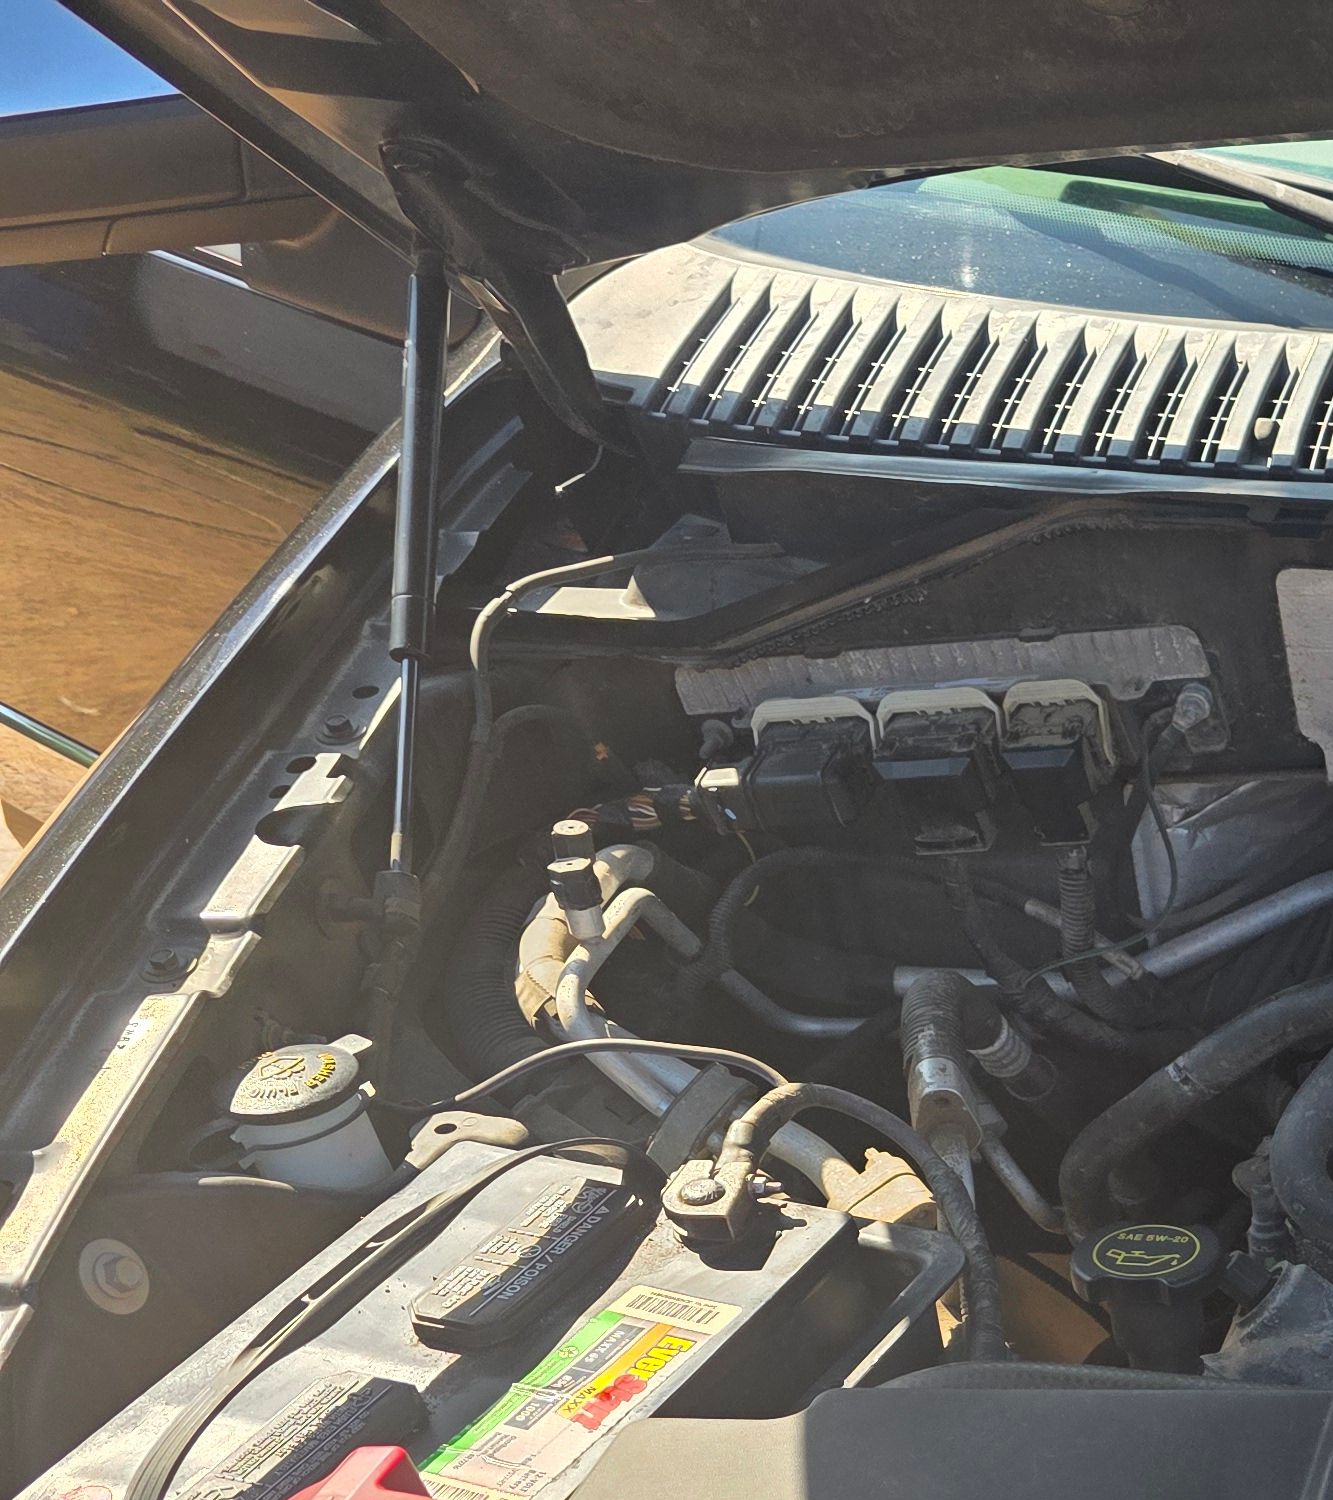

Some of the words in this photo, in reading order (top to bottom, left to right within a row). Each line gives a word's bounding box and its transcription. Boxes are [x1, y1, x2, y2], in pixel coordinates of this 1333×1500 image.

[304, 1051, 336, 1089] WASHER
[550, 1214, 602, 1255] DANGER
[1117, 1233, 1143, 1241] SAE
[1146, 1234, 1190, 1243] 5W-20
[497, 1262, 547, 1300] POISON
[598, 1330, 626, 1353] MAXX
[572, 1335, 697, 1430] EverStart
[515, 1402, 542, 1422] 1000
[562, 1386, 596, 1413] MAXX
[508, 1469, 535, 1489] Battery
[522, 1471, 547, 1493] 12-VOLT
